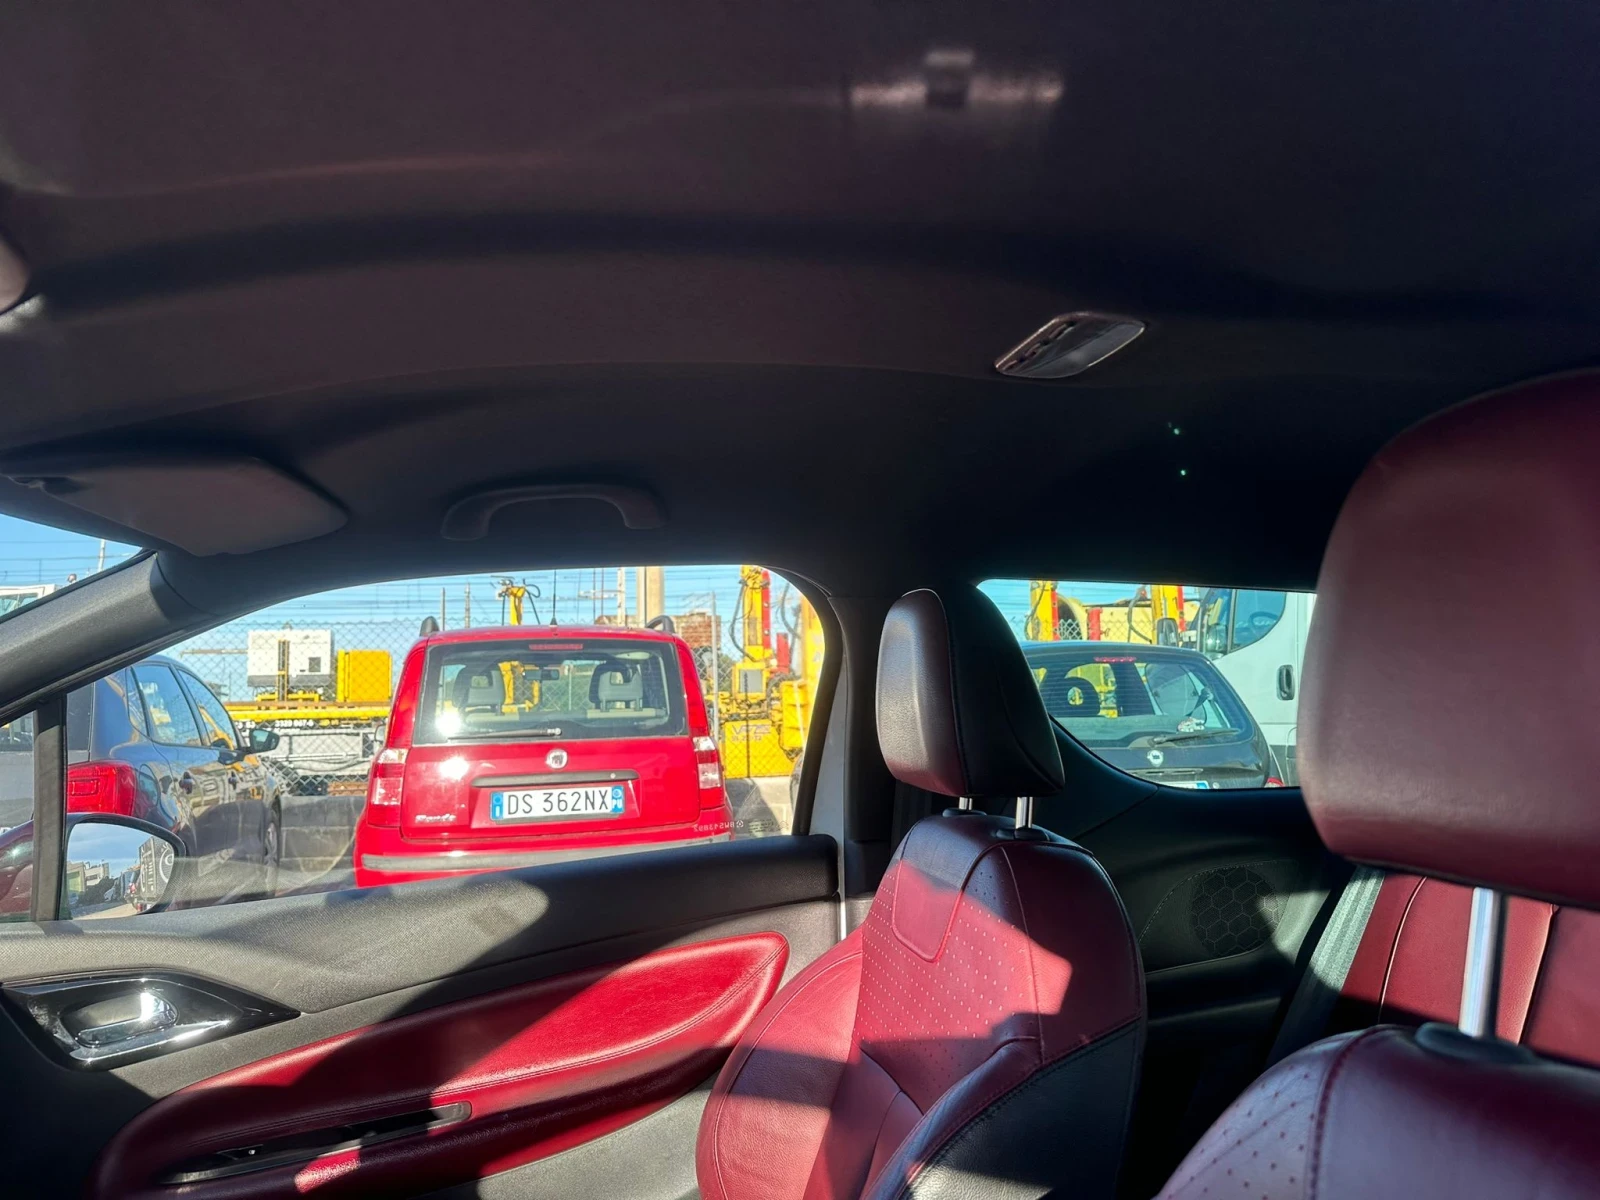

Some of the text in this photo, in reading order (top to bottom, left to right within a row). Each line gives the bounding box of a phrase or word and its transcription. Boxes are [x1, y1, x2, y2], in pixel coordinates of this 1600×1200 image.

[508, 794, 532, 815] DS
[543, 789, 608, 813] 362NX
[612, 798, 623, 809] PU
